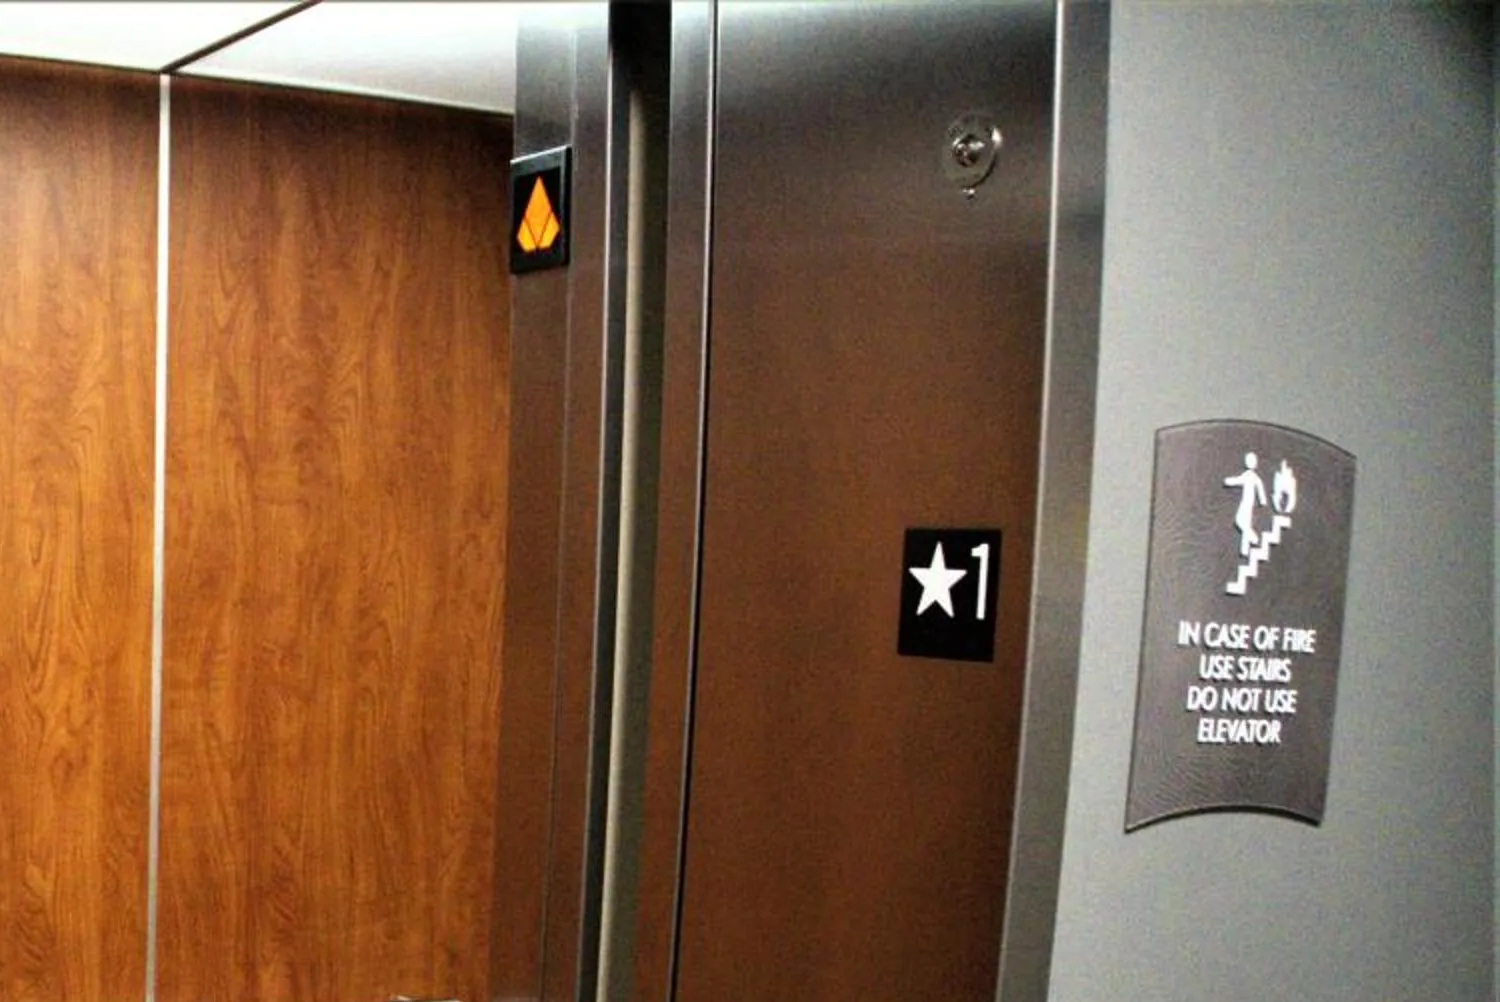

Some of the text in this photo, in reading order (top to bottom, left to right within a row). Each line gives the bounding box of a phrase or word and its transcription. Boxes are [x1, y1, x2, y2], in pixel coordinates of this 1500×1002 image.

[971, 542, 990, 621] 1
[1177, 620, 1317, 653] IN CASE OF FIRE
[1200, 654, 1292, 683] USE STAIRS
[1186, 685, 1298, 714] DO NOT USE
[1197, 717, 1282, 744] ELEVATOR
